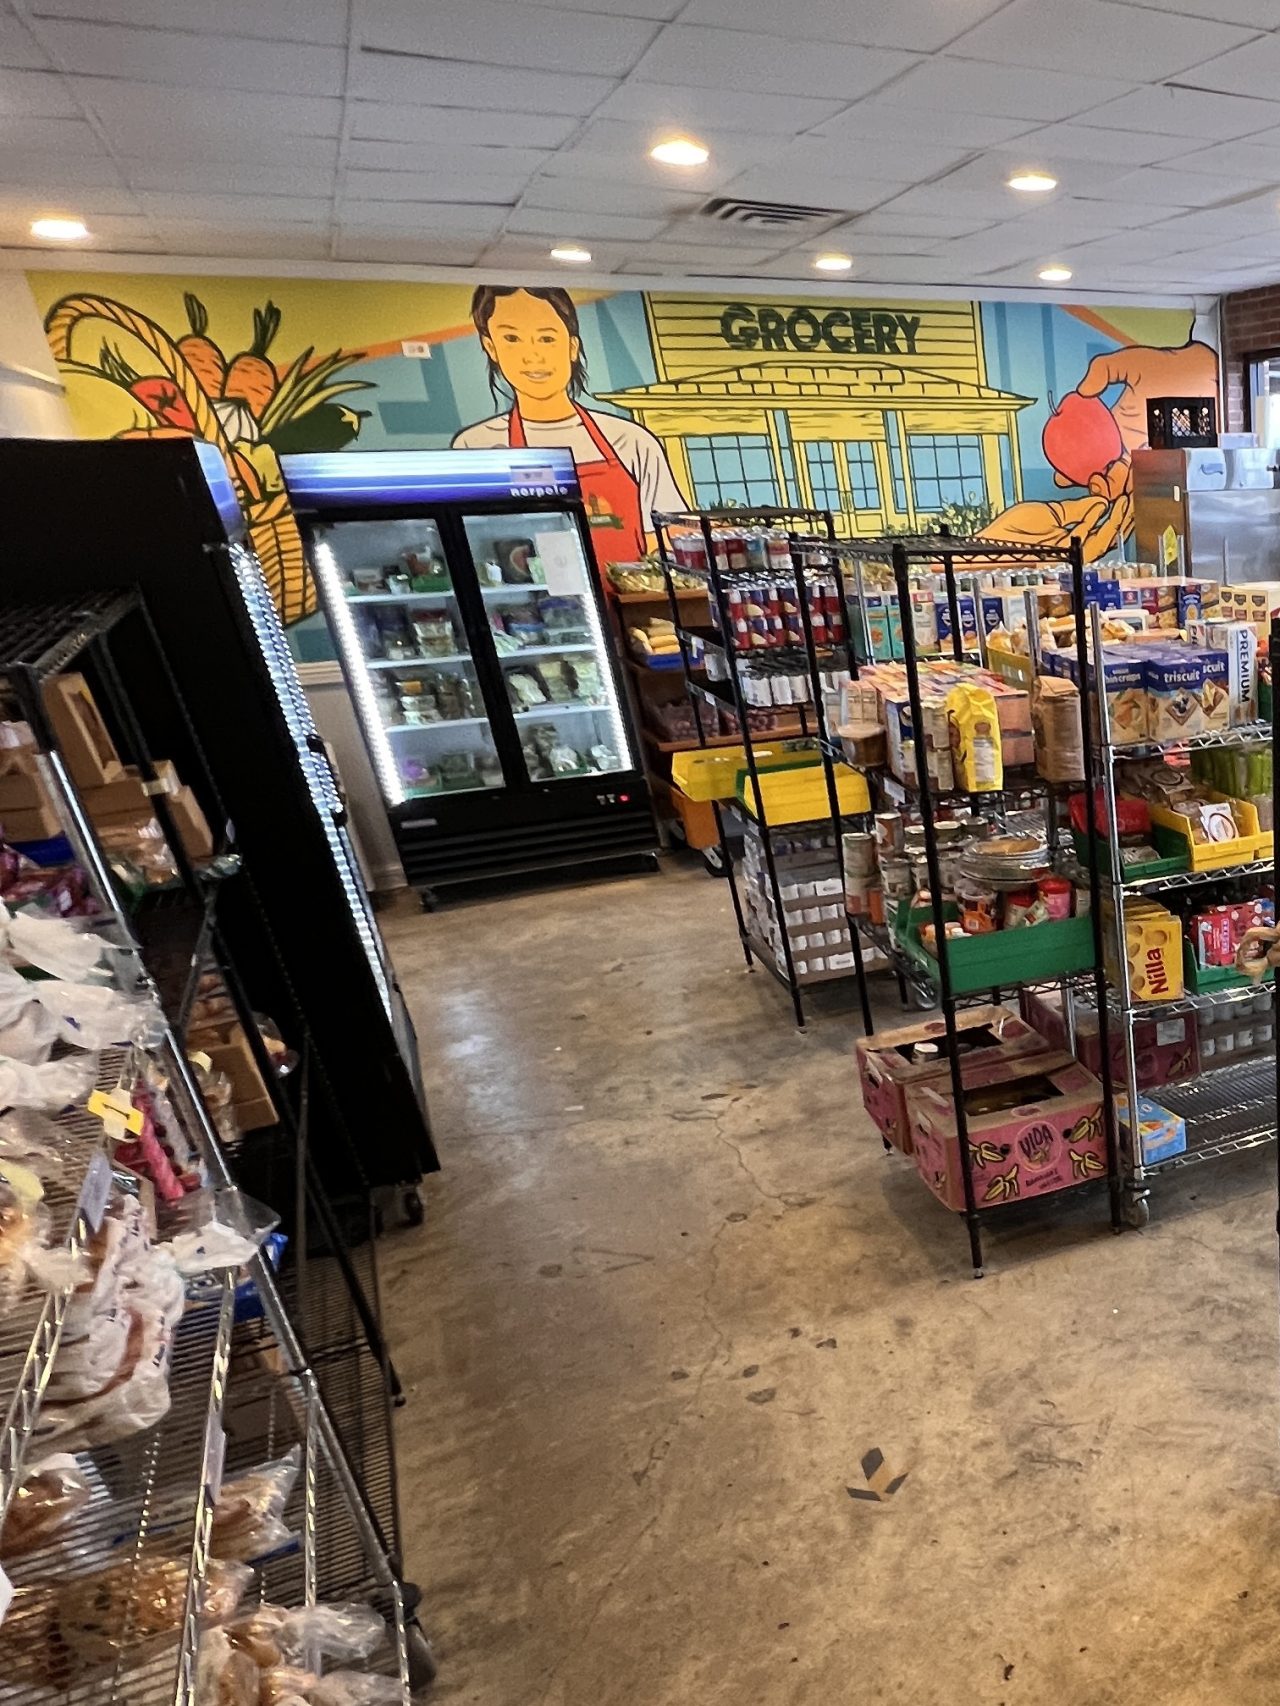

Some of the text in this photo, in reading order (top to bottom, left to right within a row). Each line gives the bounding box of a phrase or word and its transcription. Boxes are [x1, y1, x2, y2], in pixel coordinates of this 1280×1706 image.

[720, 304, 921, 354] GROCERY
[1164, 669, 1200, 683] triscuit
[1239, 629, 1250, 703] PREMIUM
[1144, 948, 1169, 995] Nilla
[1018, 1124, 1054, 1156] VIDA
